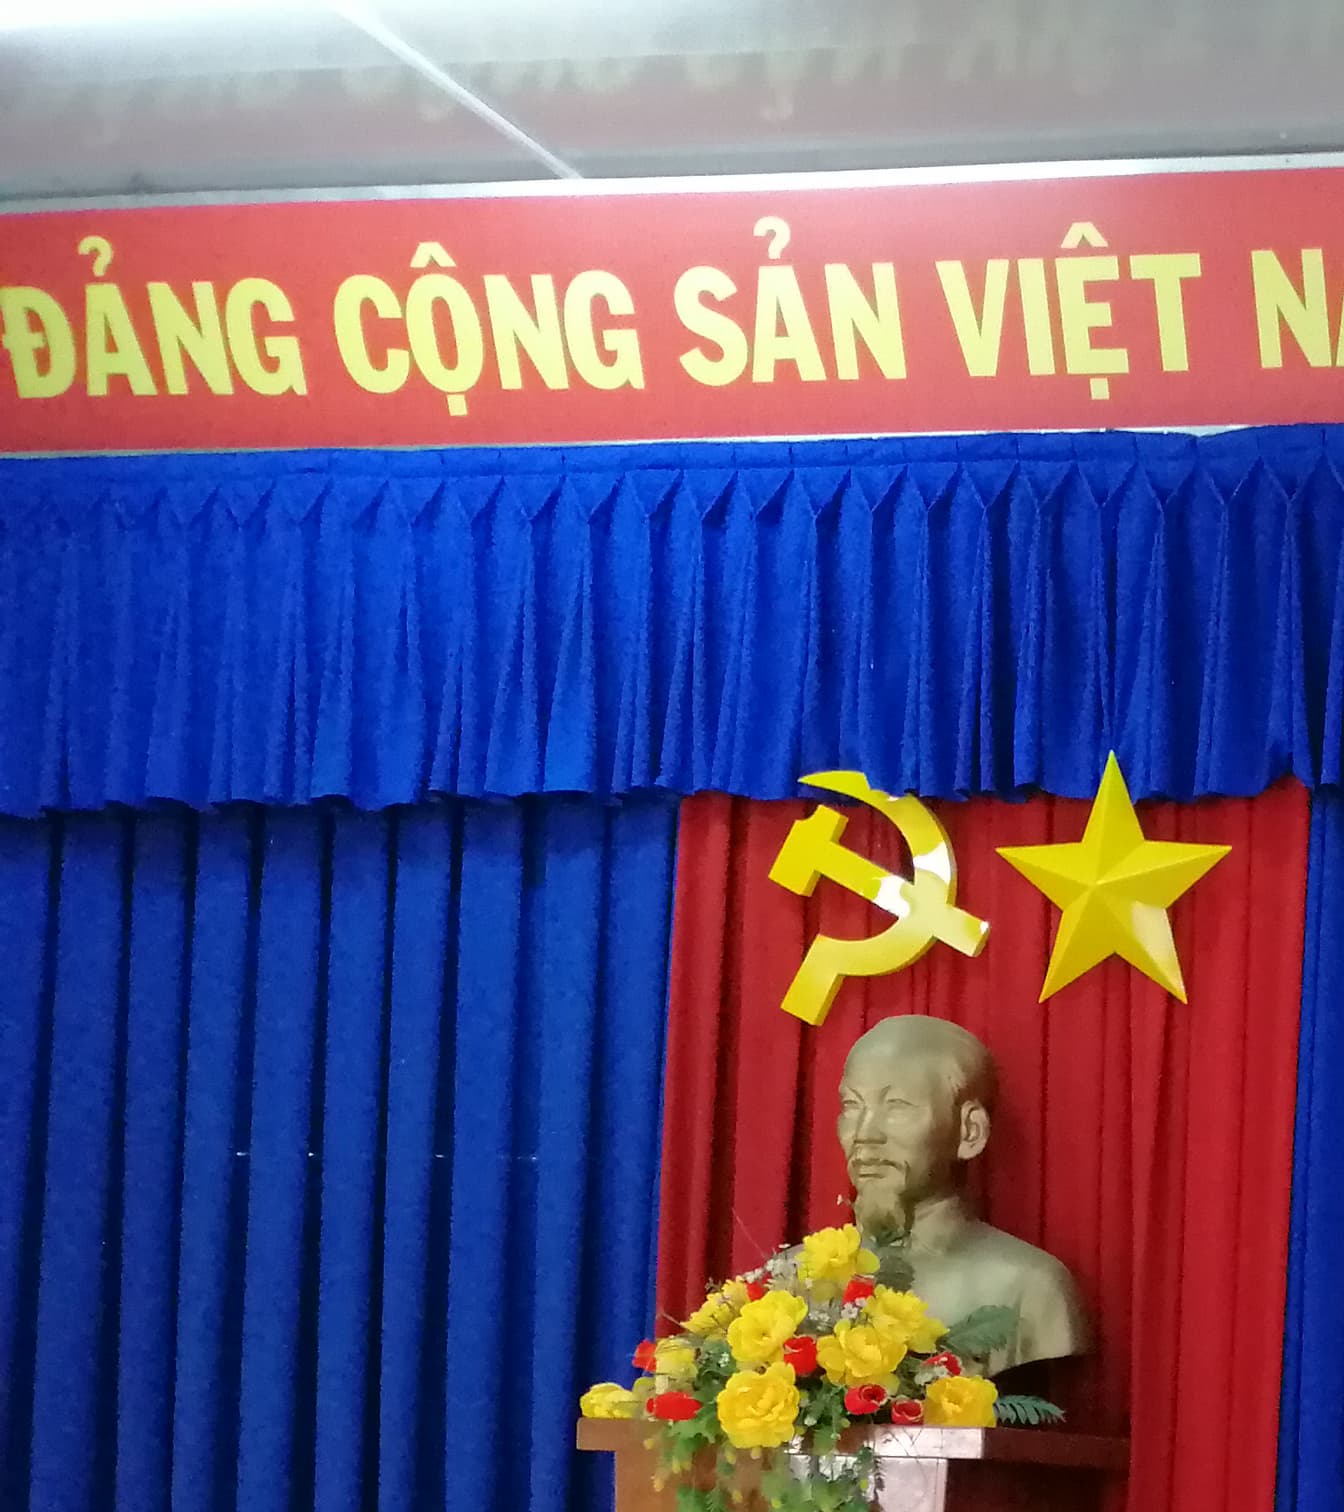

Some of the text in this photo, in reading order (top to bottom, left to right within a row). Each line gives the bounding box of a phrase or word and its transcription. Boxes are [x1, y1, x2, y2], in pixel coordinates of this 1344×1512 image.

[0, 236, 308, 399] ĐẢNG
[333, 241, 646, 417] CỘNG
[678, 216, 908, 387] SẢN
[935, 222, 1203, 400] VIỆT
